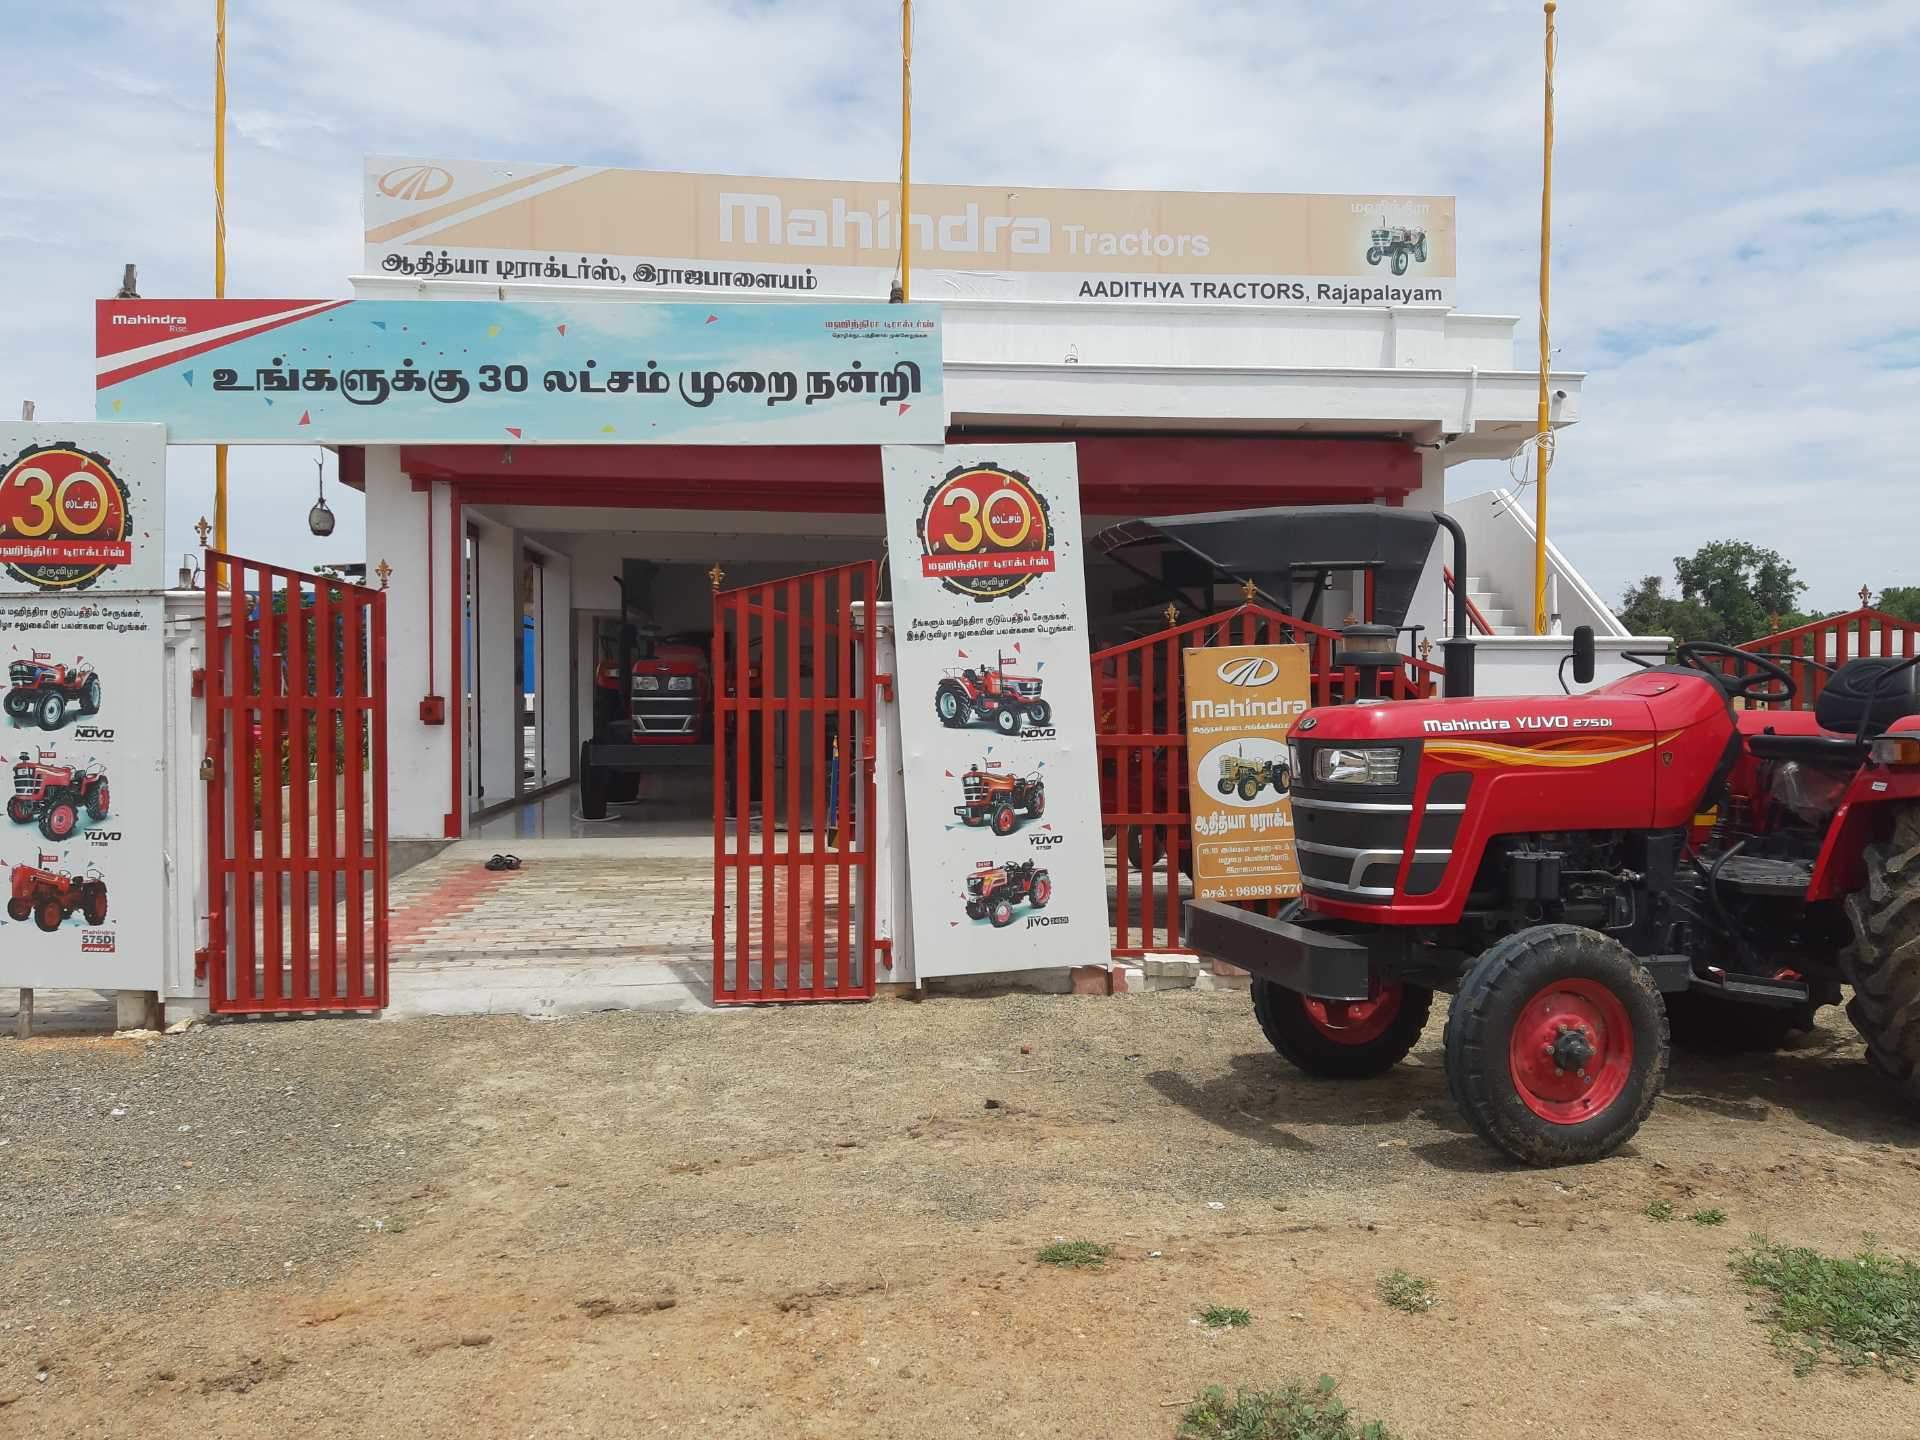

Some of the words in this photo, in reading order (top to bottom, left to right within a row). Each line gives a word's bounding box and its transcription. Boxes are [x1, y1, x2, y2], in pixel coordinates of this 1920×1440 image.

[720, 192, 1051, 254] Mahindra
[1061, 224, 1210, 258] Tractors
[382, 250, 489, 276] ஆதித்யா
[496, 256, 626, 284] டிராக்டர்ஸ்,
[633, 263, 817, 291] இராஜபாளையம்
[1078, 281, 1185, 299] AADITHYA
[1191, 282, 1311, 303] TRACTORS,
[1317, 284, 1443, 305] Rajapalayam
[112, 314, 187, 325] Mahindra
[212, 357, 471, 406] உங்களுக்கு
[479, 365, 529, 393] 30
[543, 359, 670, 394] லட்சம்
[678, 370, 798, 407] முறை
[806, 360, 922, 406] நன்றி
[12, 467, 109, 537] 30
[65, 497, 98, 510] லட்சம்
[943, 487, 1031, 552] 30
[991, 512, 1022, 525] லட்சம்
[0, 545, 58, 557] ஹிந்திரா
[1191, 697, 1308, 720] Mahindra
[1423, 718, 1511, 732] Mahindra
[1516, 716, 1569, 729] YUVO
[1572, 718, 1613, 728] 275DI
[74, 729, 115, 739] NOVO
[1020, 728, 1056, 739] NOVO
[1194, 809, 1247, 836] ஆதித்யா
[1250, 807, 1294, 832] டிராக்ட
[84, 831, 122, 841] YUVO
[1029, 835, 1063, 846] YUVO
